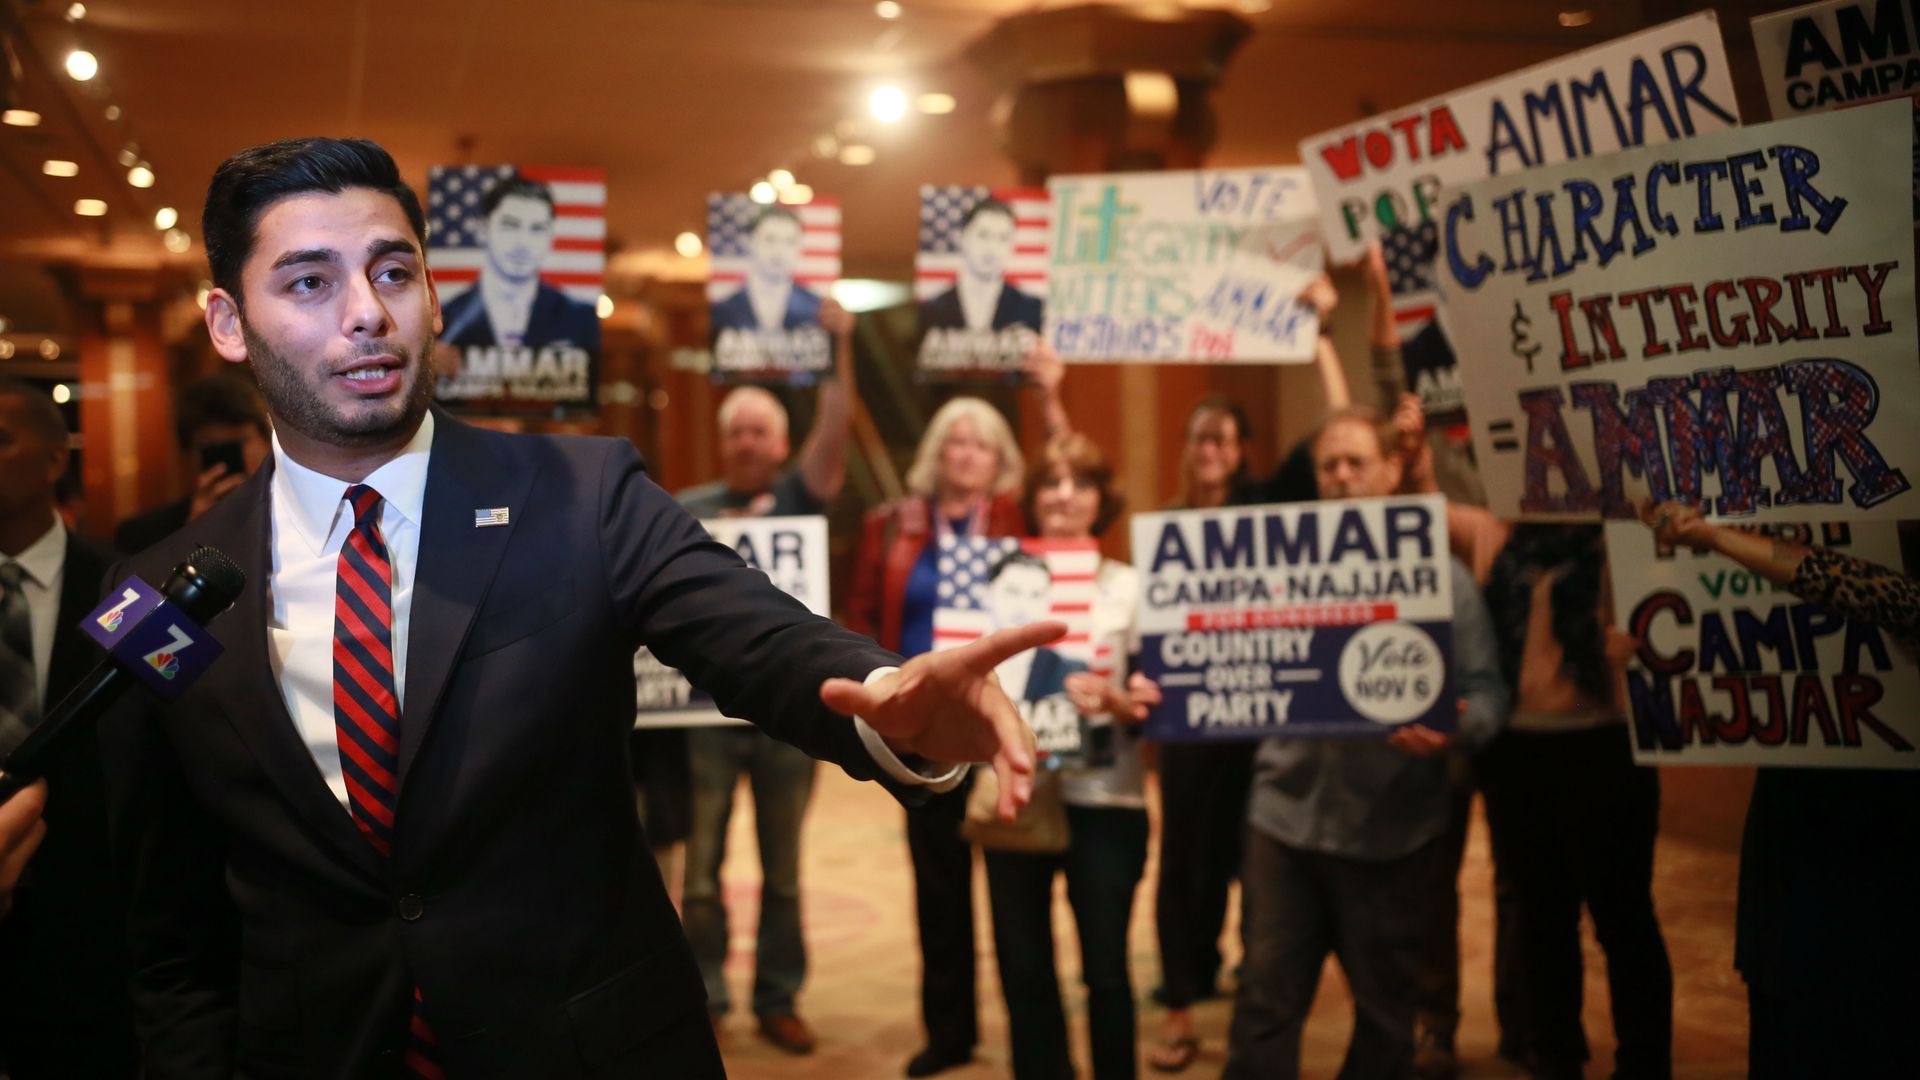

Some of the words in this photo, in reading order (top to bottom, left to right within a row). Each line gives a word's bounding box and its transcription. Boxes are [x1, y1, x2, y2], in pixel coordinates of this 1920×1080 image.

[1784, 0, 1920, 79] AM
[1319, 105, 1466, 182] VOTA
[1486, 43, 1738, 175] AMMAR
[1196, 171, 1300, 219] VOTE
[1445, 145, 1848, 290] CHARACTER
[1549, 261, 1899, 372] INTEGRITY
[1517, 358, 1911, 517] AMMAR
[1151, 505, 1434, 573] AMMAR
[97, 588, 141, 630] 7
[1149, 577, 1271, 606] CAMPA
[1286, 567, 1438, 601] NAJJAR
[143, 624, 194, 673] 7
[1160, 629, 1315, 668] COUNTRY
[1358, 637, 1431, 673] Vote
[1629, 587, 1894, 676] CAMPA
[1204, 665, 1273, 694] OVER
[1355, 680, 1406, 701] NOV
[1418, 674, 1431, 700] 6
[1186, 691, 1293, 728] PARTY
[1627, 660, 1915, 754] NAJJAR
